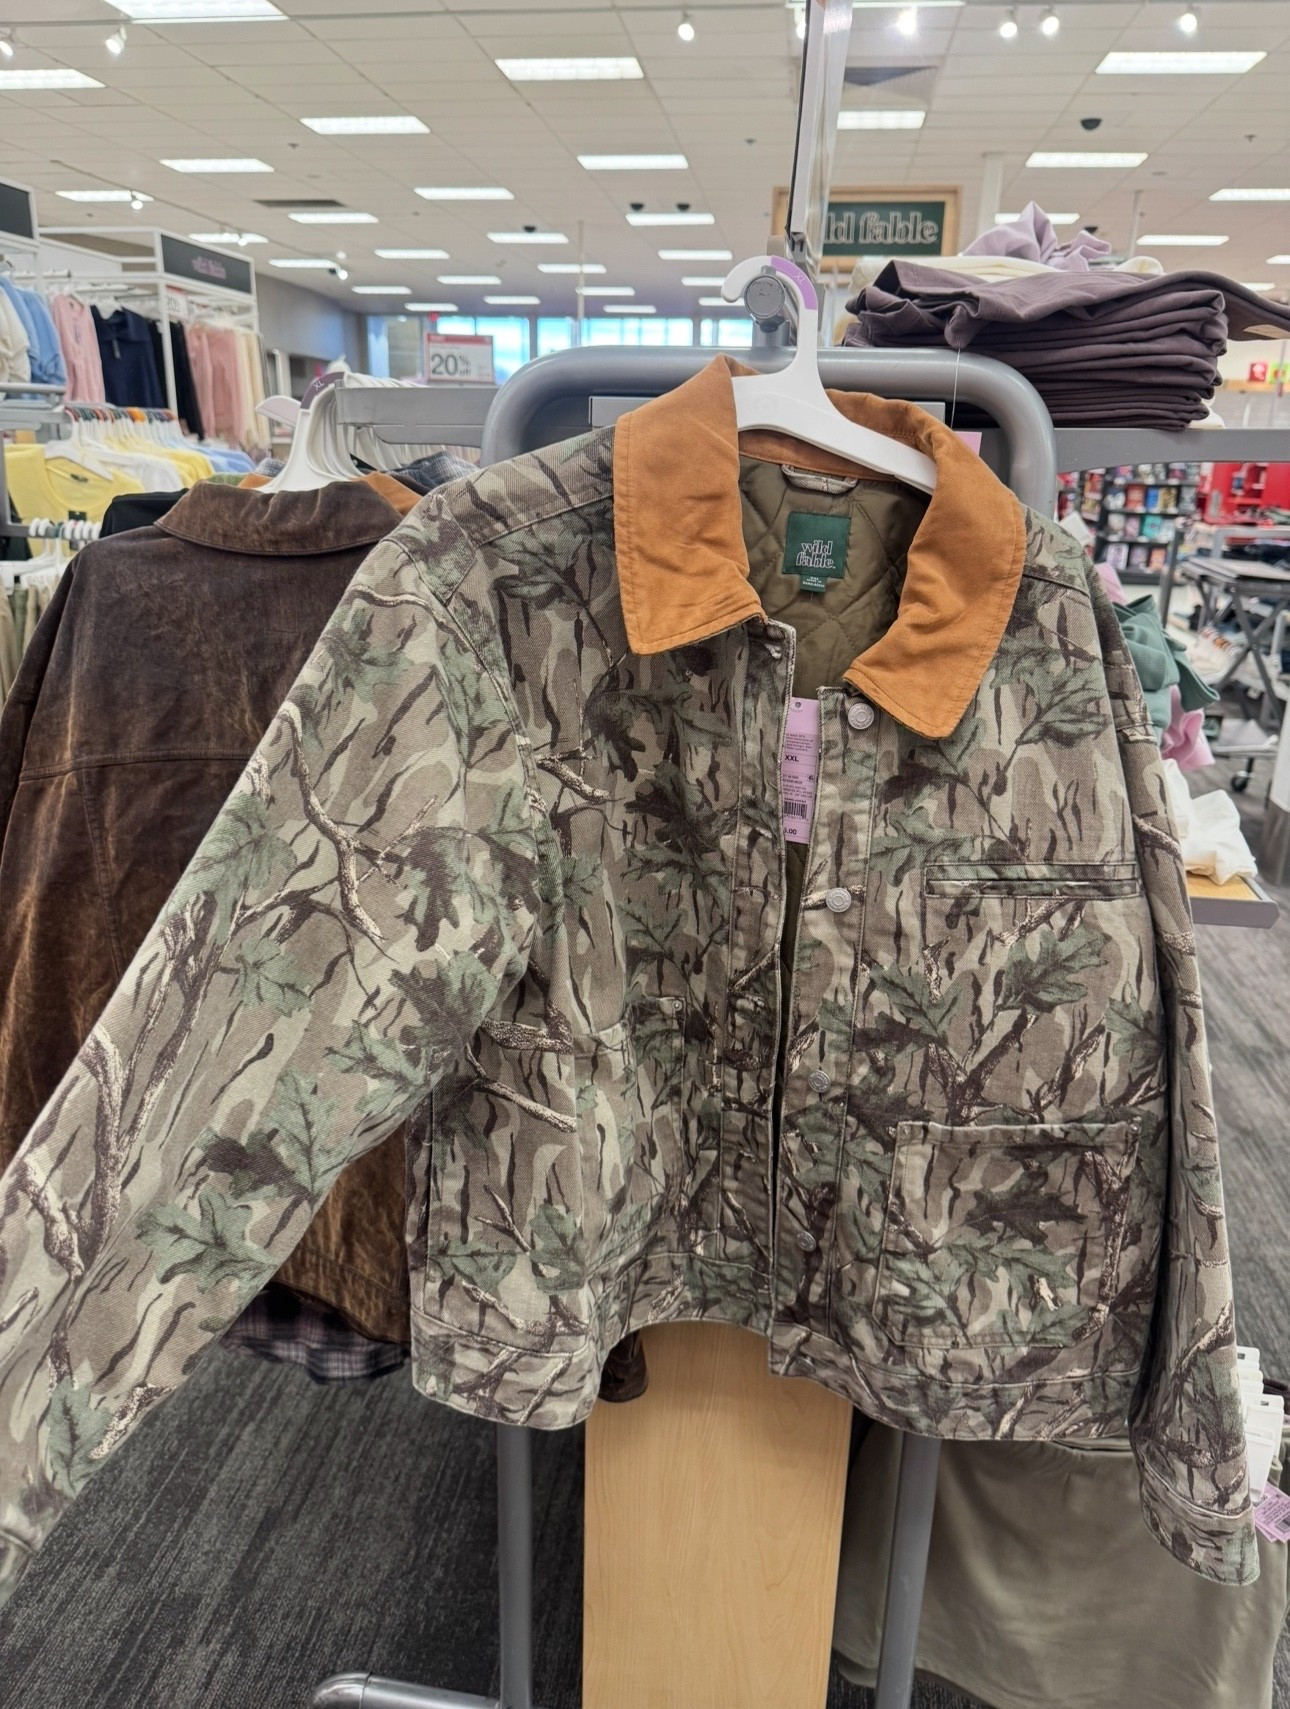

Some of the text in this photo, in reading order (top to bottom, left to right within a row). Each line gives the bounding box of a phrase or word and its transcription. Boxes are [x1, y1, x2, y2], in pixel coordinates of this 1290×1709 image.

[824, 211, 939, 244] ld fable
[313, 380, 325, 391] XL
[801, 540, 833, 555] wild
[796, 552, 834, 569] fable
[785, 754, 799, 762] XXL
